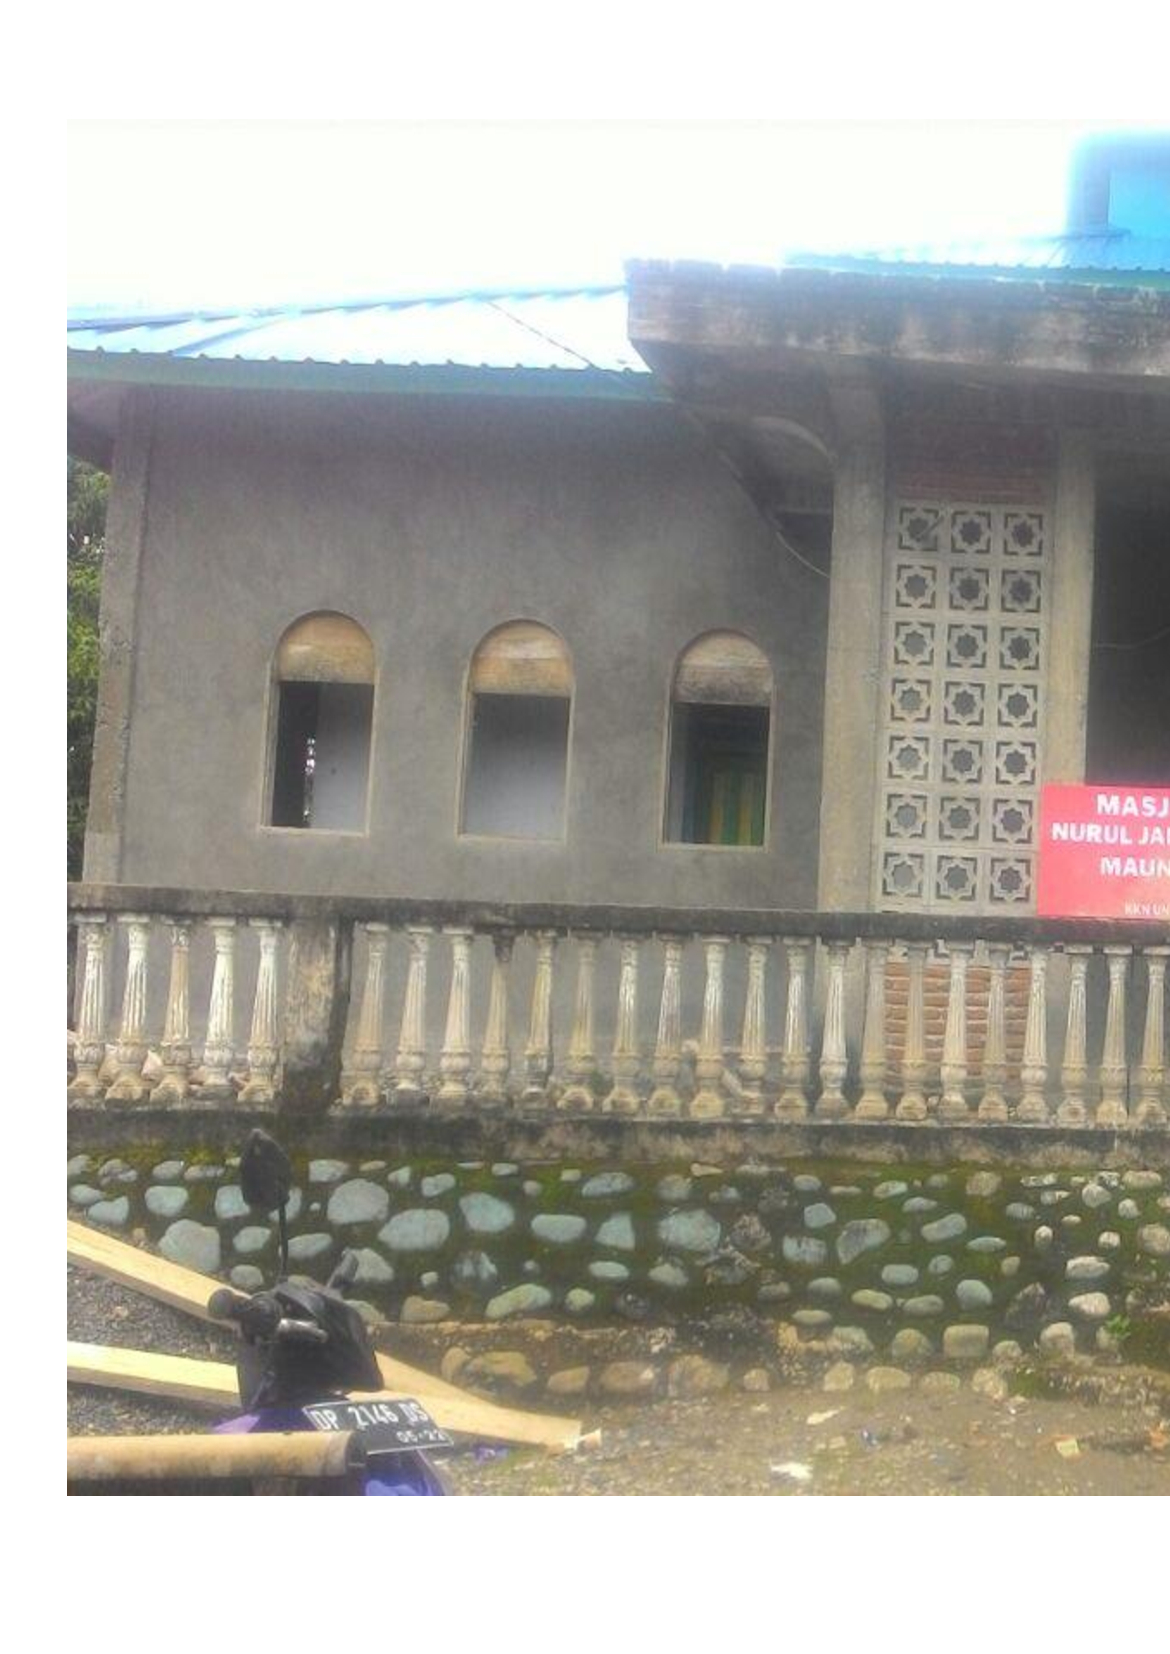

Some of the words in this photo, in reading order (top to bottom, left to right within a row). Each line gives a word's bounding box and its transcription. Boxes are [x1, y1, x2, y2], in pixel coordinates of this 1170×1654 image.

[1051, 822, 1133, 845] NURUL
[309, 1409, 340, 1430] DP
[348, 1403, 399, 1428] 2146
